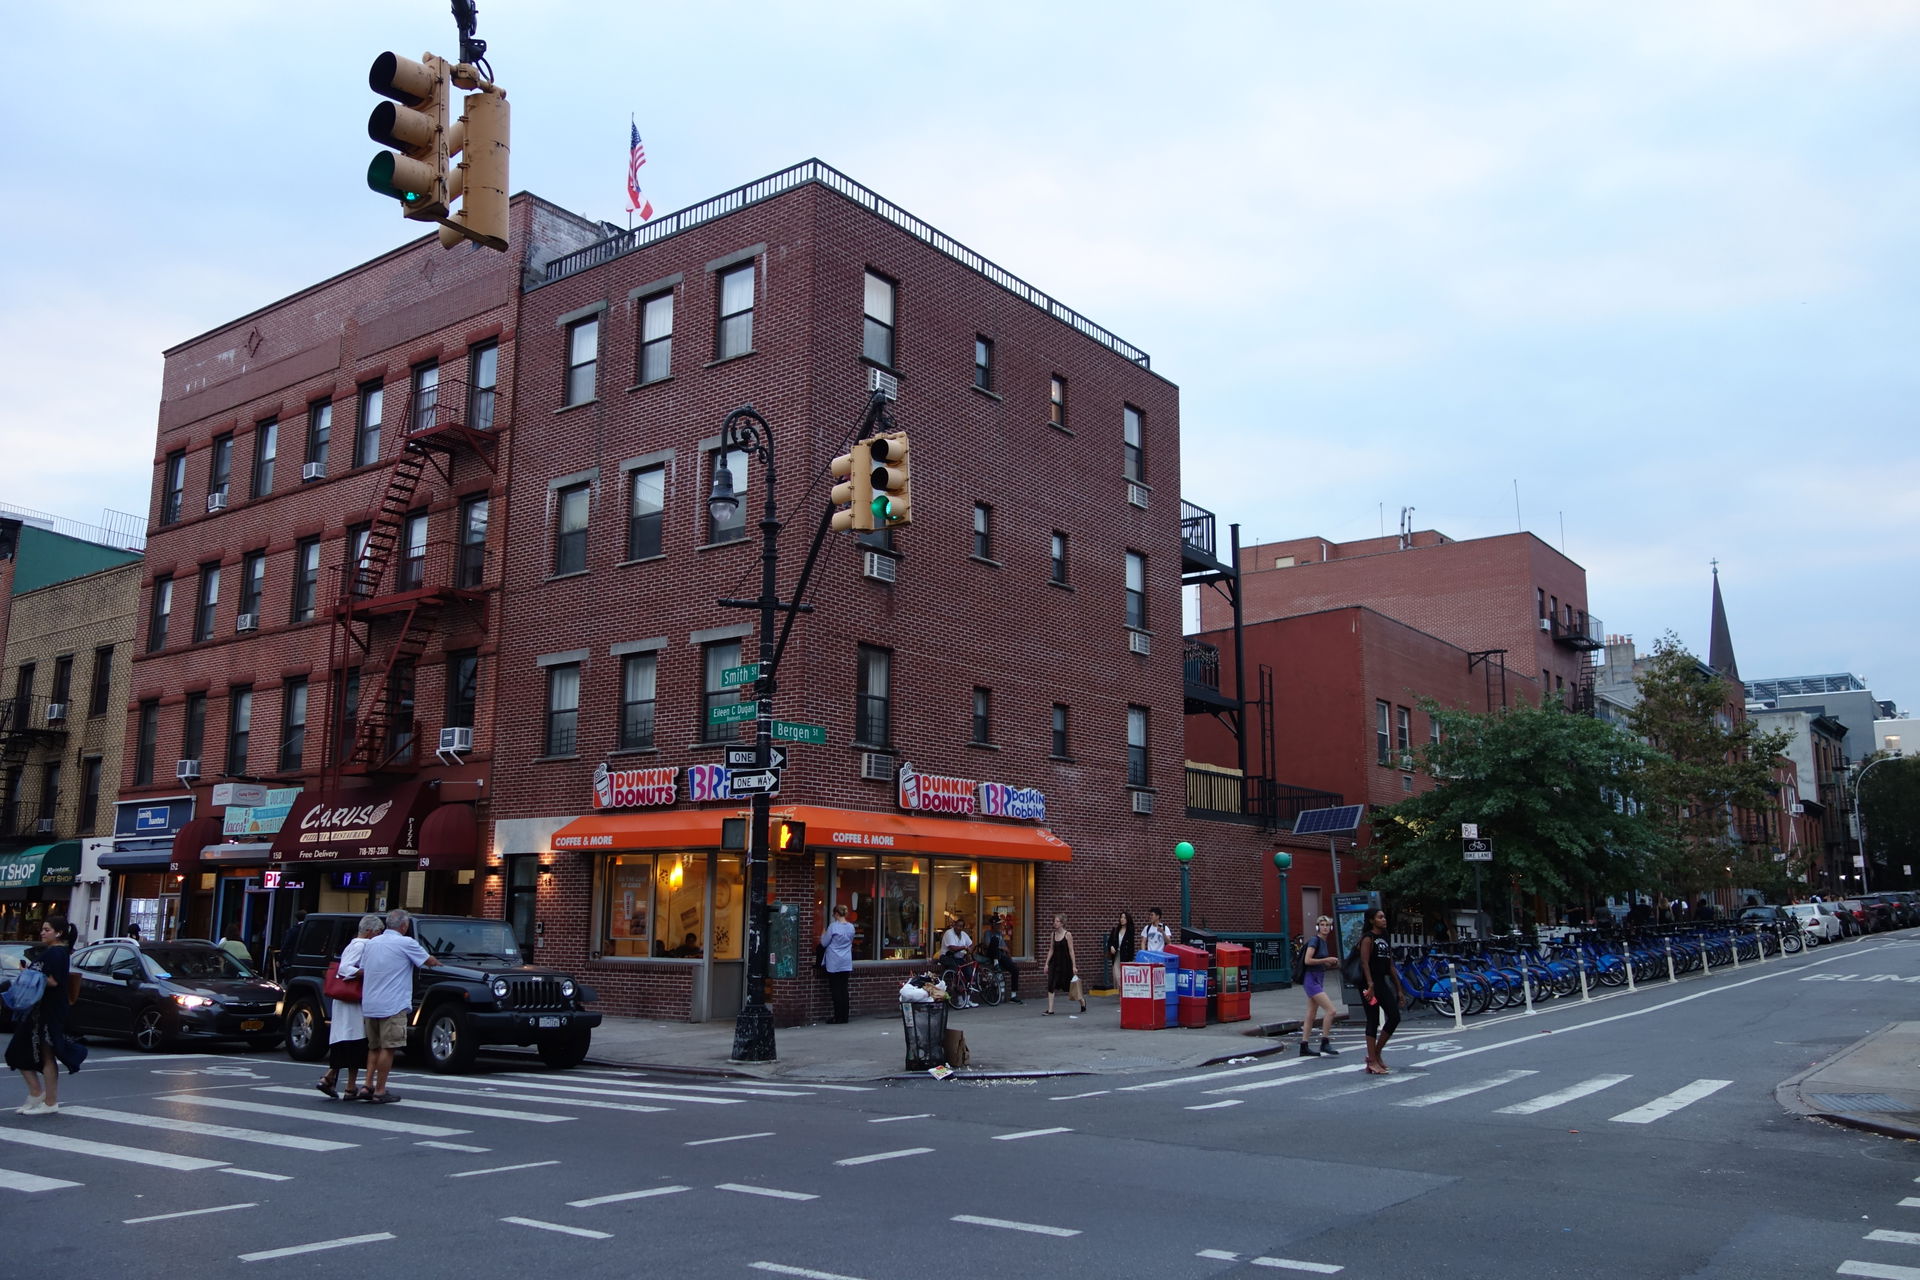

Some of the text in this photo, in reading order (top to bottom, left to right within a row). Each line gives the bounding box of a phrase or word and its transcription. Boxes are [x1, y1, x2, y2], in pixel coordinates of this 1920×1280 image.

[724, 669, 748, 684] Smith
[713, 704, 755, 718] Eileen C Dugan
[777, 723, 809, 741] Bergen
[734, 752, 752, 762] ONE
[615, 768, 677, 789] DUNKIN'
[688, 765, 724, 800] BR
[737, 775, 773, 787] ONE WAY
[922, 775, 976, 796] DUNKIN'
[615, 786, 674, 806] DONUTS
[986, 784, 1011, 815] BR
[1011, 786, 1045, 803] baskin
[922, 793, 974, 814] DONUTS
[1012, 804, 1045, 820] robbins
[406, 817, 415, 848] PIZZA
[555, 835, 613, 847] COFFEE & MORE
[832, 832, 894, 846] COFFEE & MORE
[299, 850, 313, 858] Free
[314, 849, 339, 859] Delivery
[7, 863, 36, 880] SHOP
[42, 875, 73, 883] GIFT SHOP
